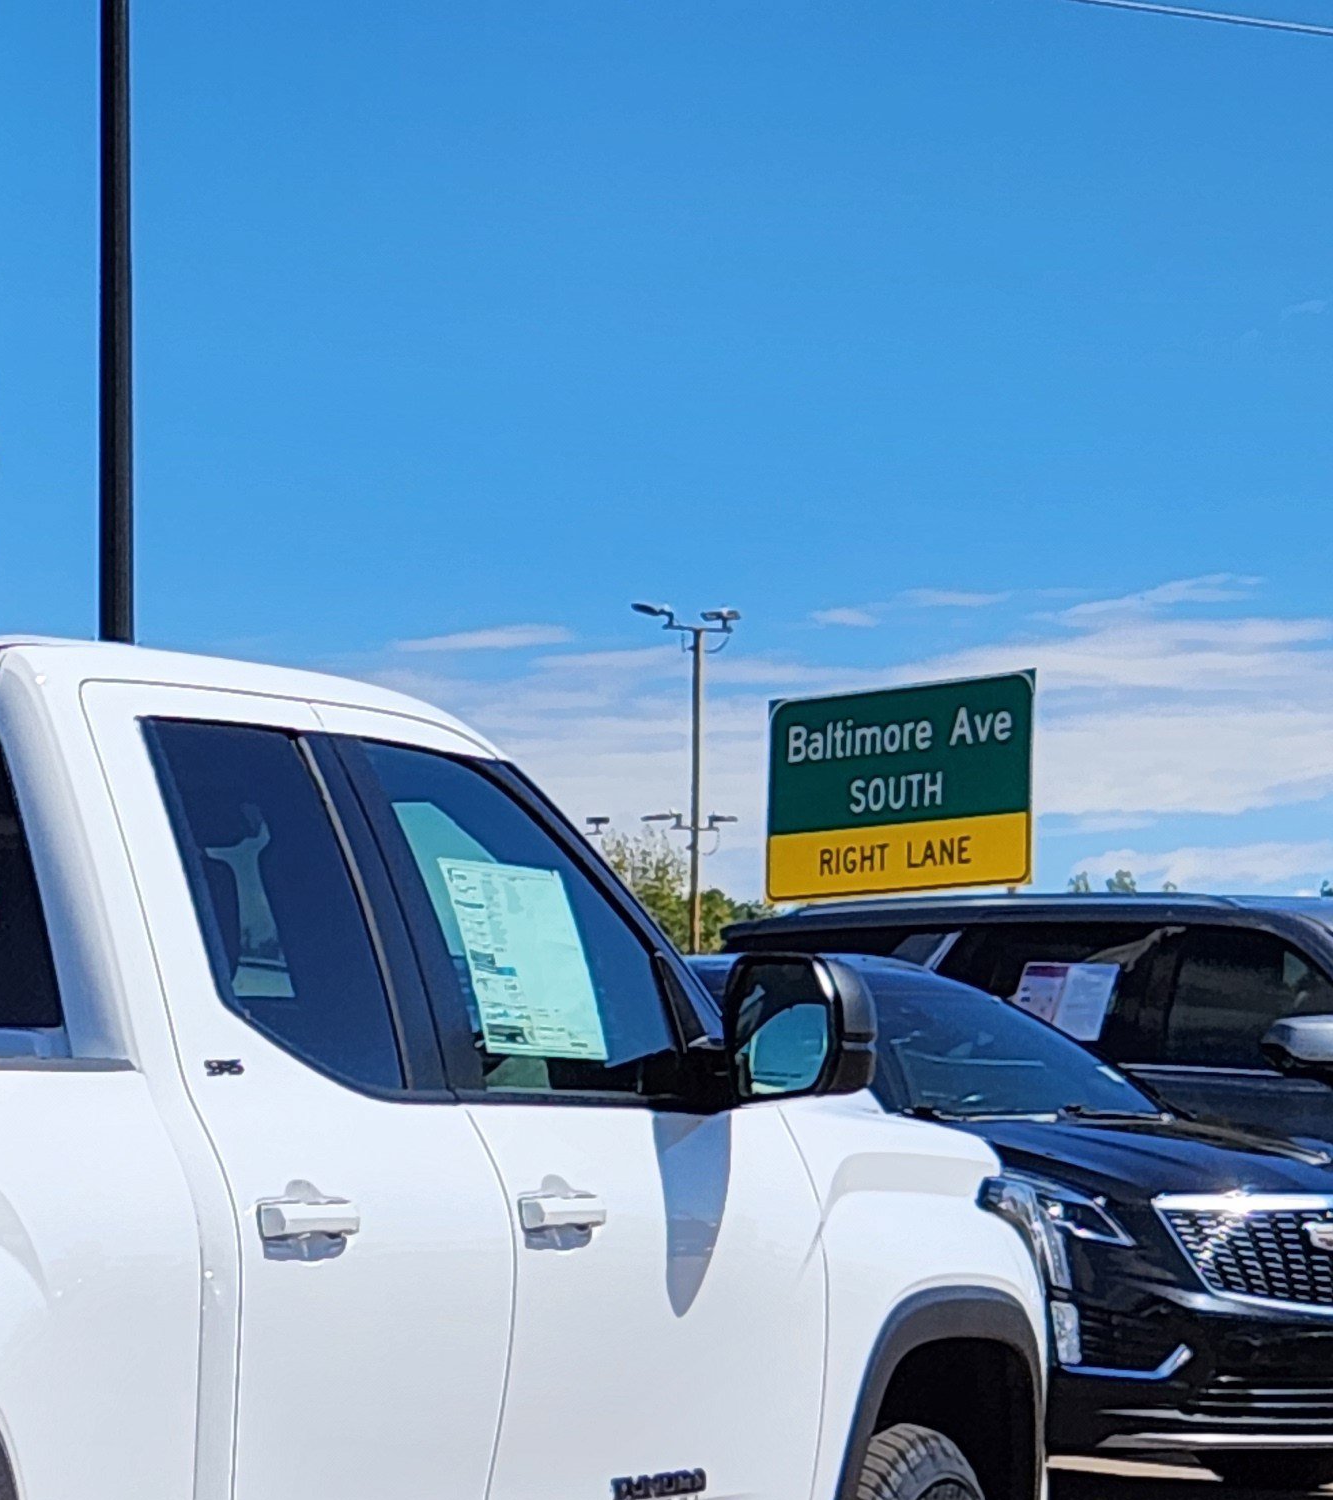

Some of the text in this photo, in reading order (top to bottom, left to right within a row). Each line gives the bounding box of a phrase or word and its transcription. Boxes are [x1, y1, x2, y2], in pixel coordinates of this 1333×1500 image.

[787, 706, 1013, 764] Baltimore Ave
[849, 771, 943, 814] SOUTH
[819, 835, 972, 877] RIGHT LANE
